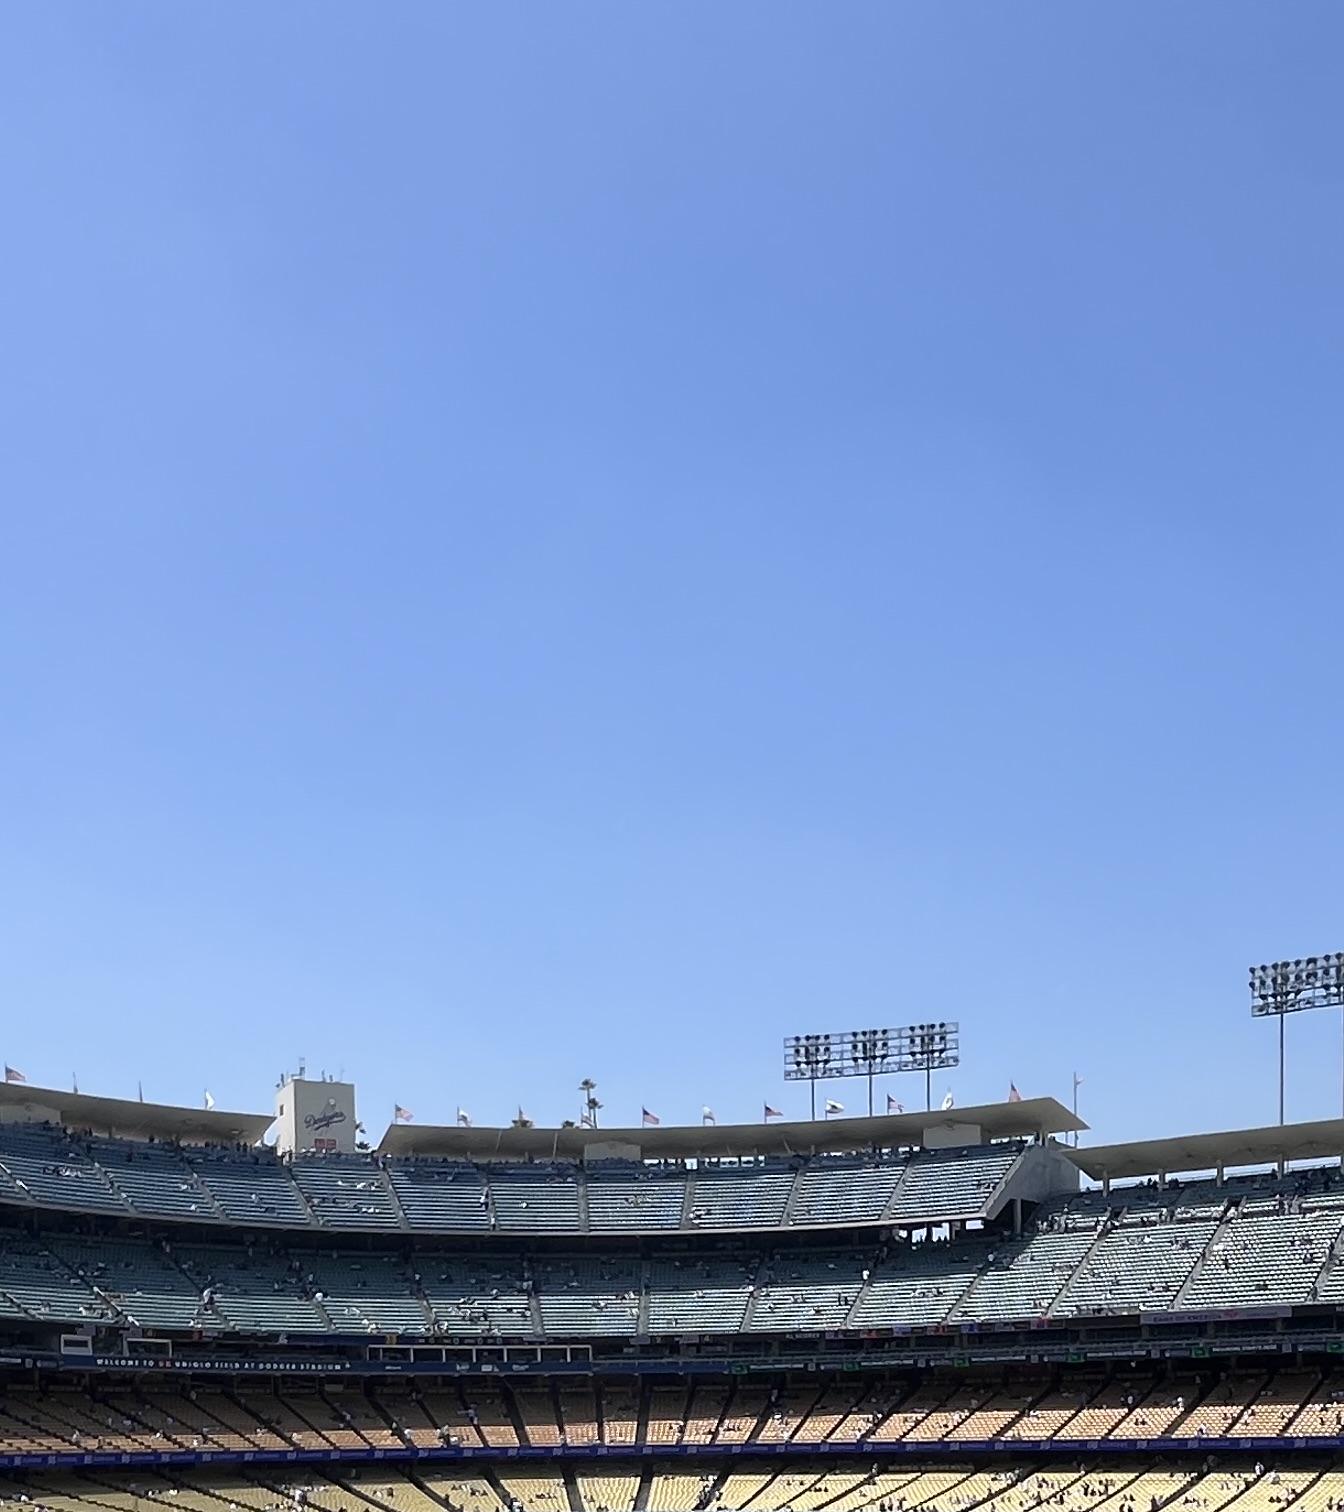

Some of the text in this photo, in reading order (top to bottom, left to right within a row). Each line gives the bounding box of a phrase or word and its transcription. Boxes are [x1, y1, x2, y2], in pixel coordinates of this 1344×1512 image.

[96, 1358, 140, 1367] WELCOME
[143, 1359, 155, 1367] TO
[259, 1362, 296, 1371] DODGER
[300, 1363, 341, 1371] STADIUM
